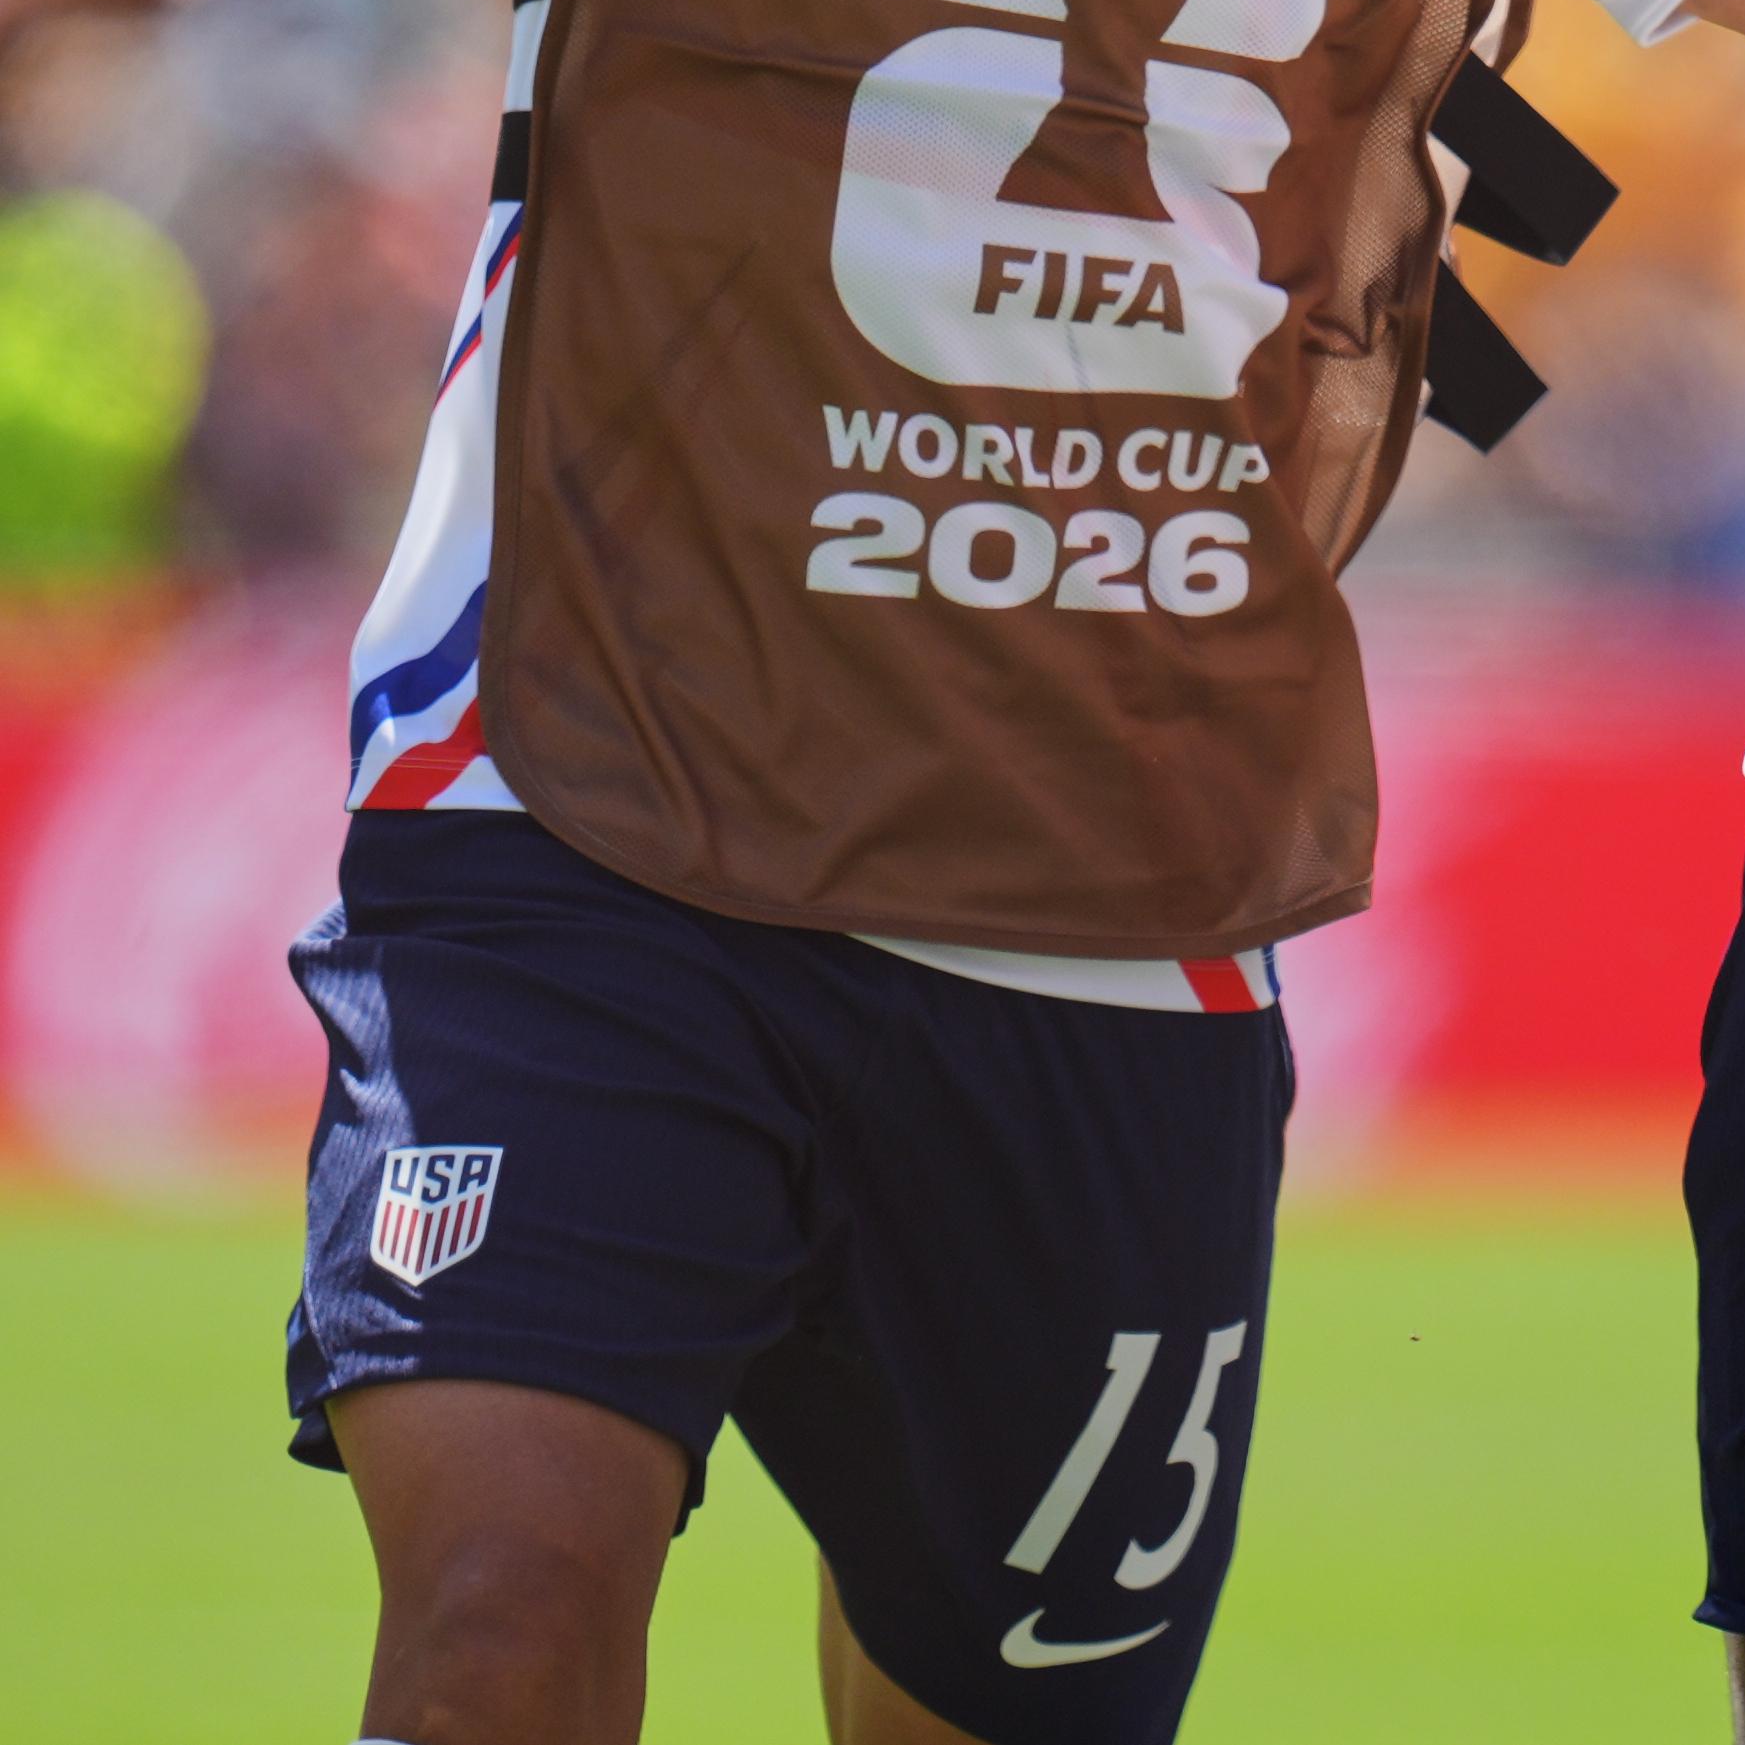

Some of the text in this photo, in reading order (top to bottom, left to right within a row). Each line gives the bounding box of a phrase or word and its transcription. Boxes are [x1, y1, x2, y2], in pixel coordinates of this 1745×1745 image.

[972, 243, 1186, 336] FIFA
[822, 404, 1271, 494] WORLD CUP
[806, 490, 1251, 617] 2026
[390, 1154, 494, 1205] USA
[1003, 1320, 1249, 1591] 15
